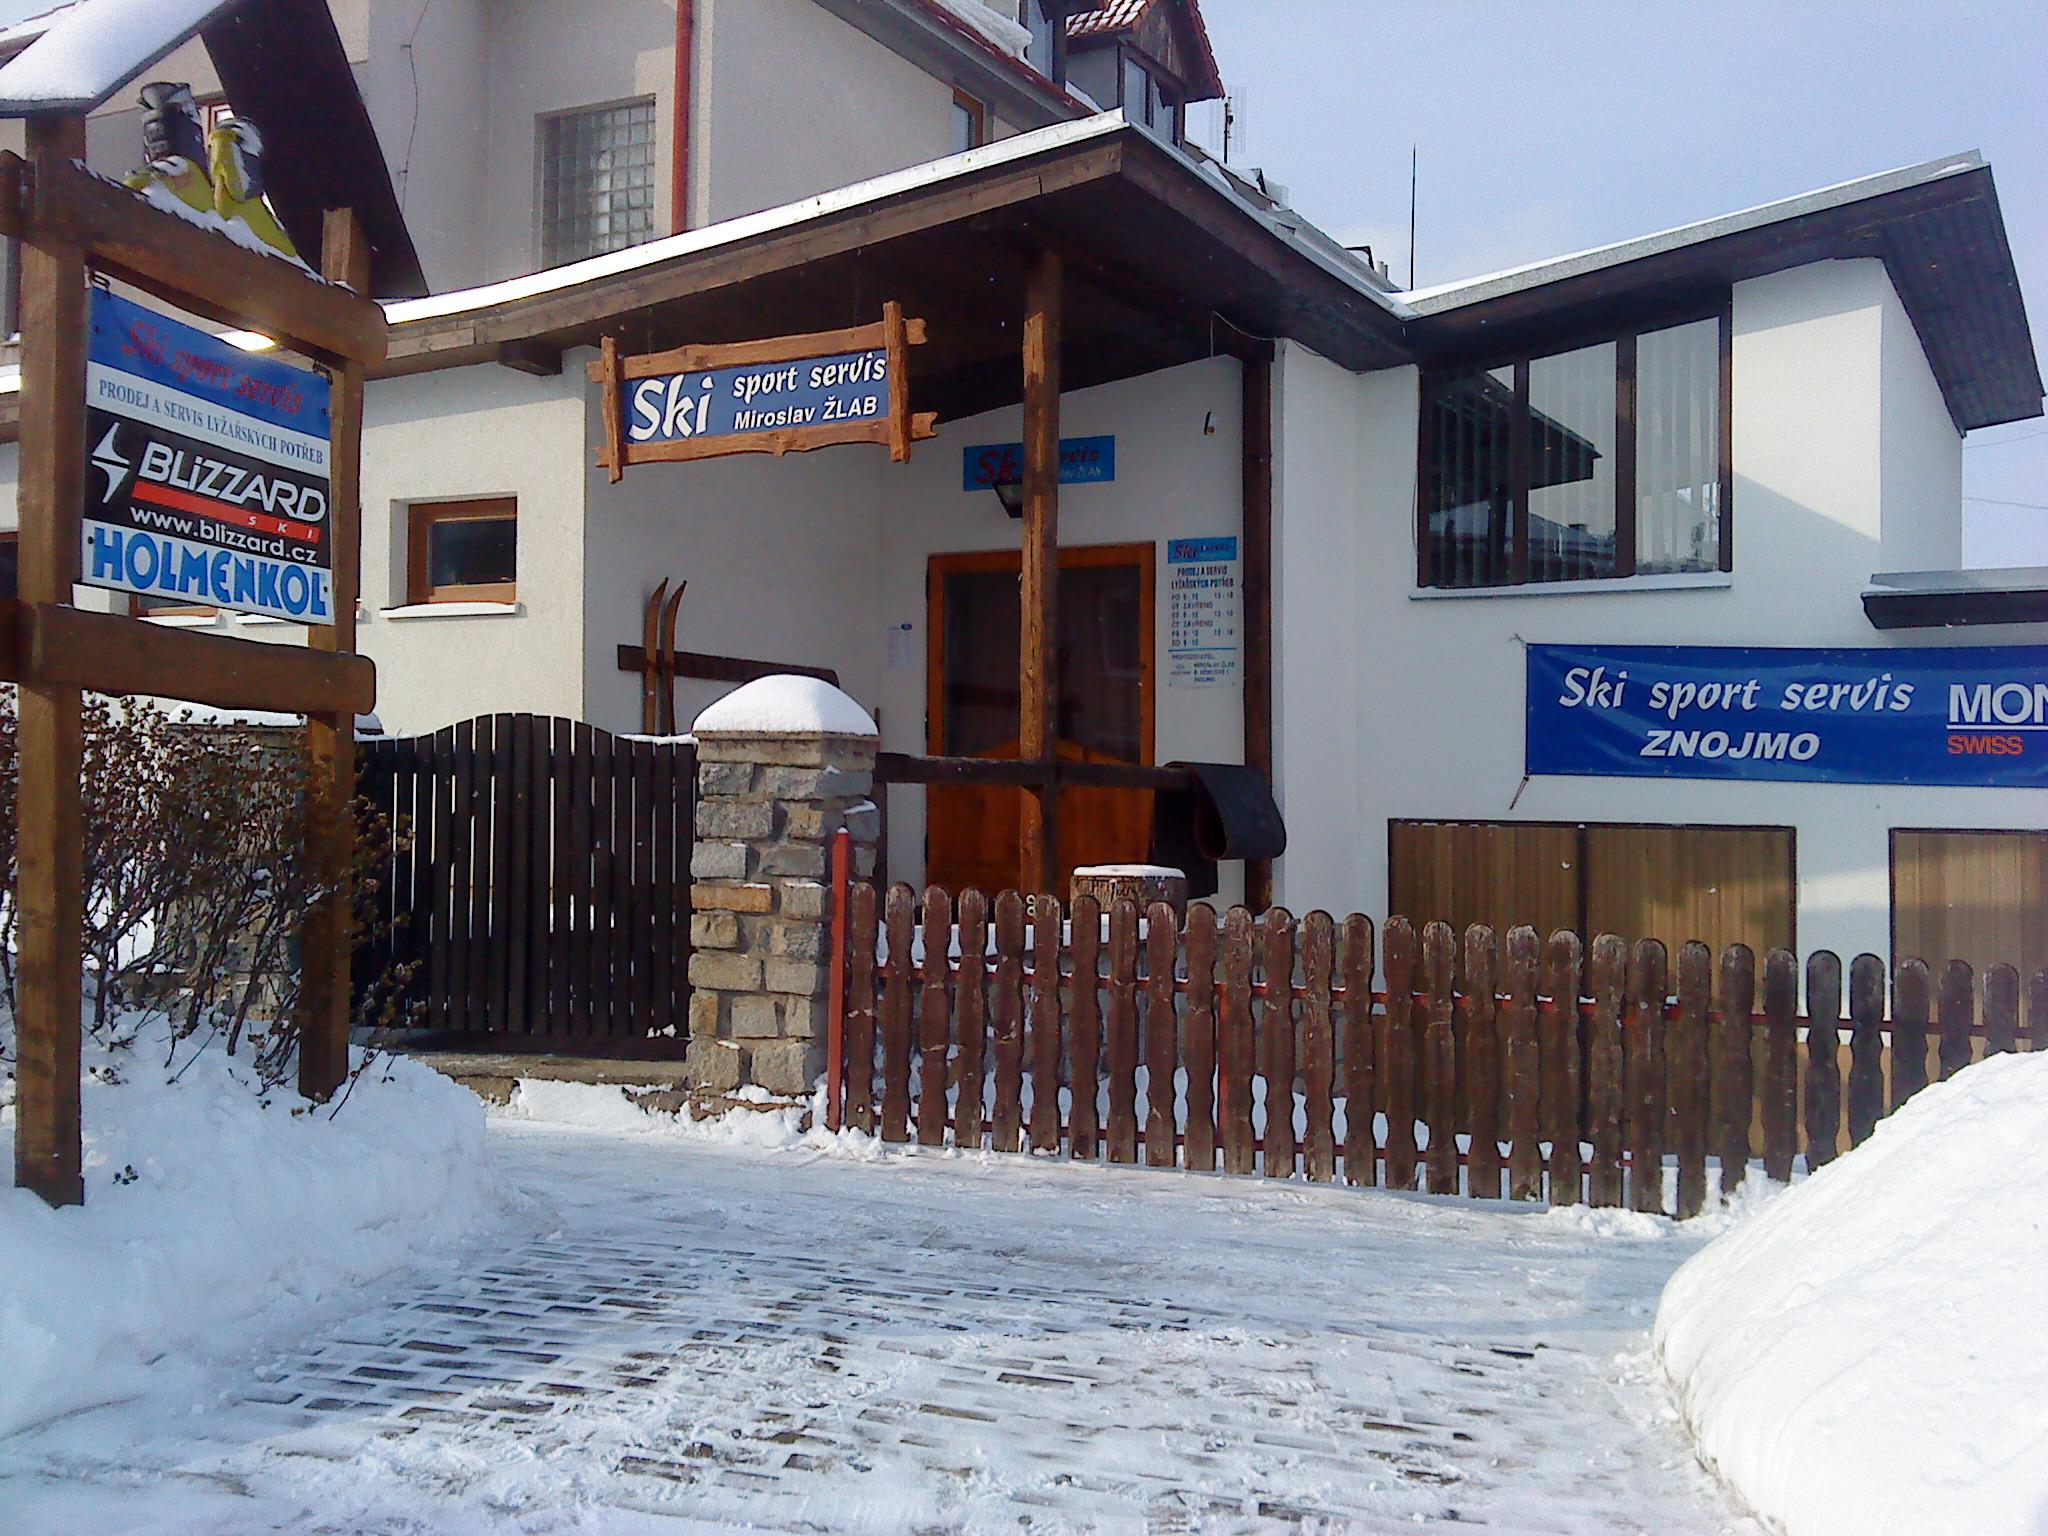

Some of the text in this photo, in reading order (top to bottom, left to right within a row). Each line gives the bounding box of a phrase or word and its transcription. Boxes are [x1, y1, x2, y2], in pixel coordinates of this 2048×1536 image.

[121, 320, 304, 415] Ski sport servis
[629, 351, 888, 441] Ski sport servis
[99, 379, 149, 408] PRODEJ
[152, 399, 162, 414] A
[164, 397, 203, 427] SERVIS
[280, 440, 323, 465] POTŘEB
[734, 395, 878, 431] Miroslav ŽLAB
[976, 448, 1018, 484] Sk
[130, 504, 318, 564] www.blizzard.cz
[92, 527, 327, 616] HOLMENKOL
[1558, 666, 1916, 720] Ski sport servis
[1640, 729, 1821, 761] ZNOJMO
[1947, 735, 2024, 756] SWISS
